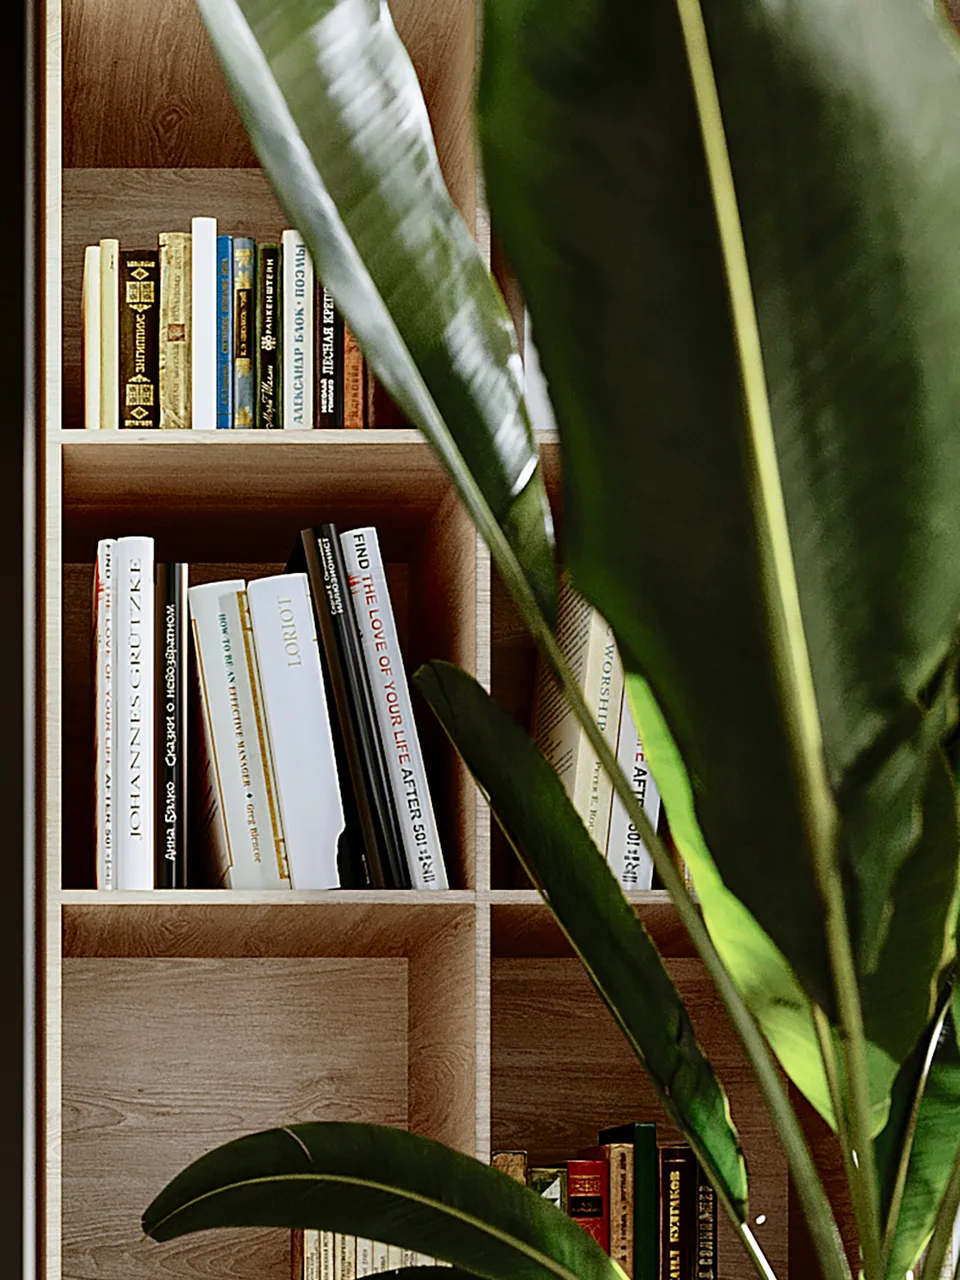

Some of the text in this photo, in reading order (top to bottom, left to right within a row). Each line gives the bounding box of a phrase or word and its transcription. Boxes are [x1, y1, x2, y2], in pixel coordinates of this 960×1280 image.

[293, 243, 305, 423] АЛЕКСАНДР БЛОК ПОЭМЫ
[322, 328, 335, 375] ЛЕСНАЯ
[352, 533, 369, 569] FIND
[361, 576, 375, 605] THE
[216, 613, 228, 637] HOW
[221, 638, 230, 653] TO
[277, 596, 302, 668] LORIOT
[368, 609, 383, 651] LOVE
[224, 654, 234, 668] BE
[226, 670, 236, 684] AN
[378, 655, 391, 674] OF
[127, 557, 143, 840] JOHANNES GRÜTZKE
[166, 702, 175, 711] о
[383, 681, 402, 726] YOUR
[596, 643, 615, 731] WORSHIP
[229, 686, 243, 738] EFFECTIVE
[164, 716, 176, 766] Сказки
[393, 730, 410, 764] LIFE
[237, 740, 250, 786] MANAGER
[164, 781, 176, 822] Бялко
[244, 803, 256, 824] Greg
[400, 768, 422, 820] AFTER
[164, 827, 176, 860] Анна
[412, 822, 427, 846] 50!
[668, 1170, 680, 1242] БУЛГАКОВ
